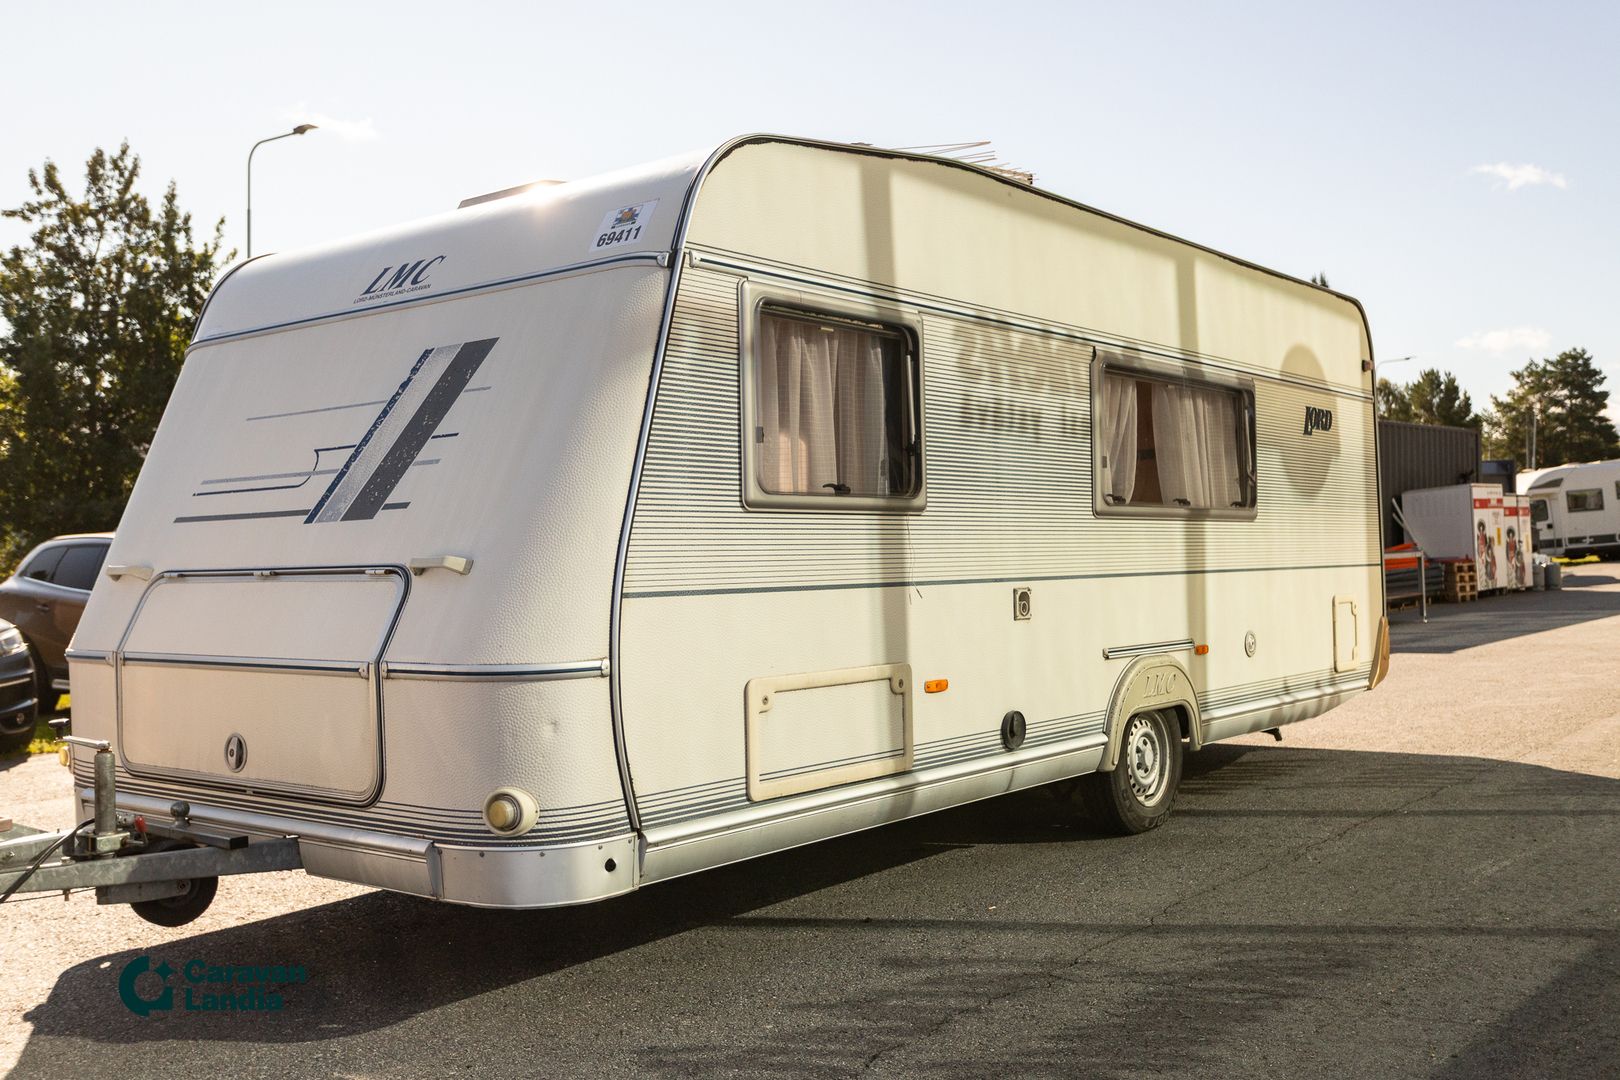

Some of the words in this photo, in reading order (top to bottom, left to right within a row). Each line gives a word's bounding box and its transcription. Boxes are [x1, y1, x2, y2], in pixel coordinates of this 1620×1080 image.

[596, 225, 642, 248] 69411
[360, 255, 447, 296] LMC
[1143, 671, 1177, 699] LMC
